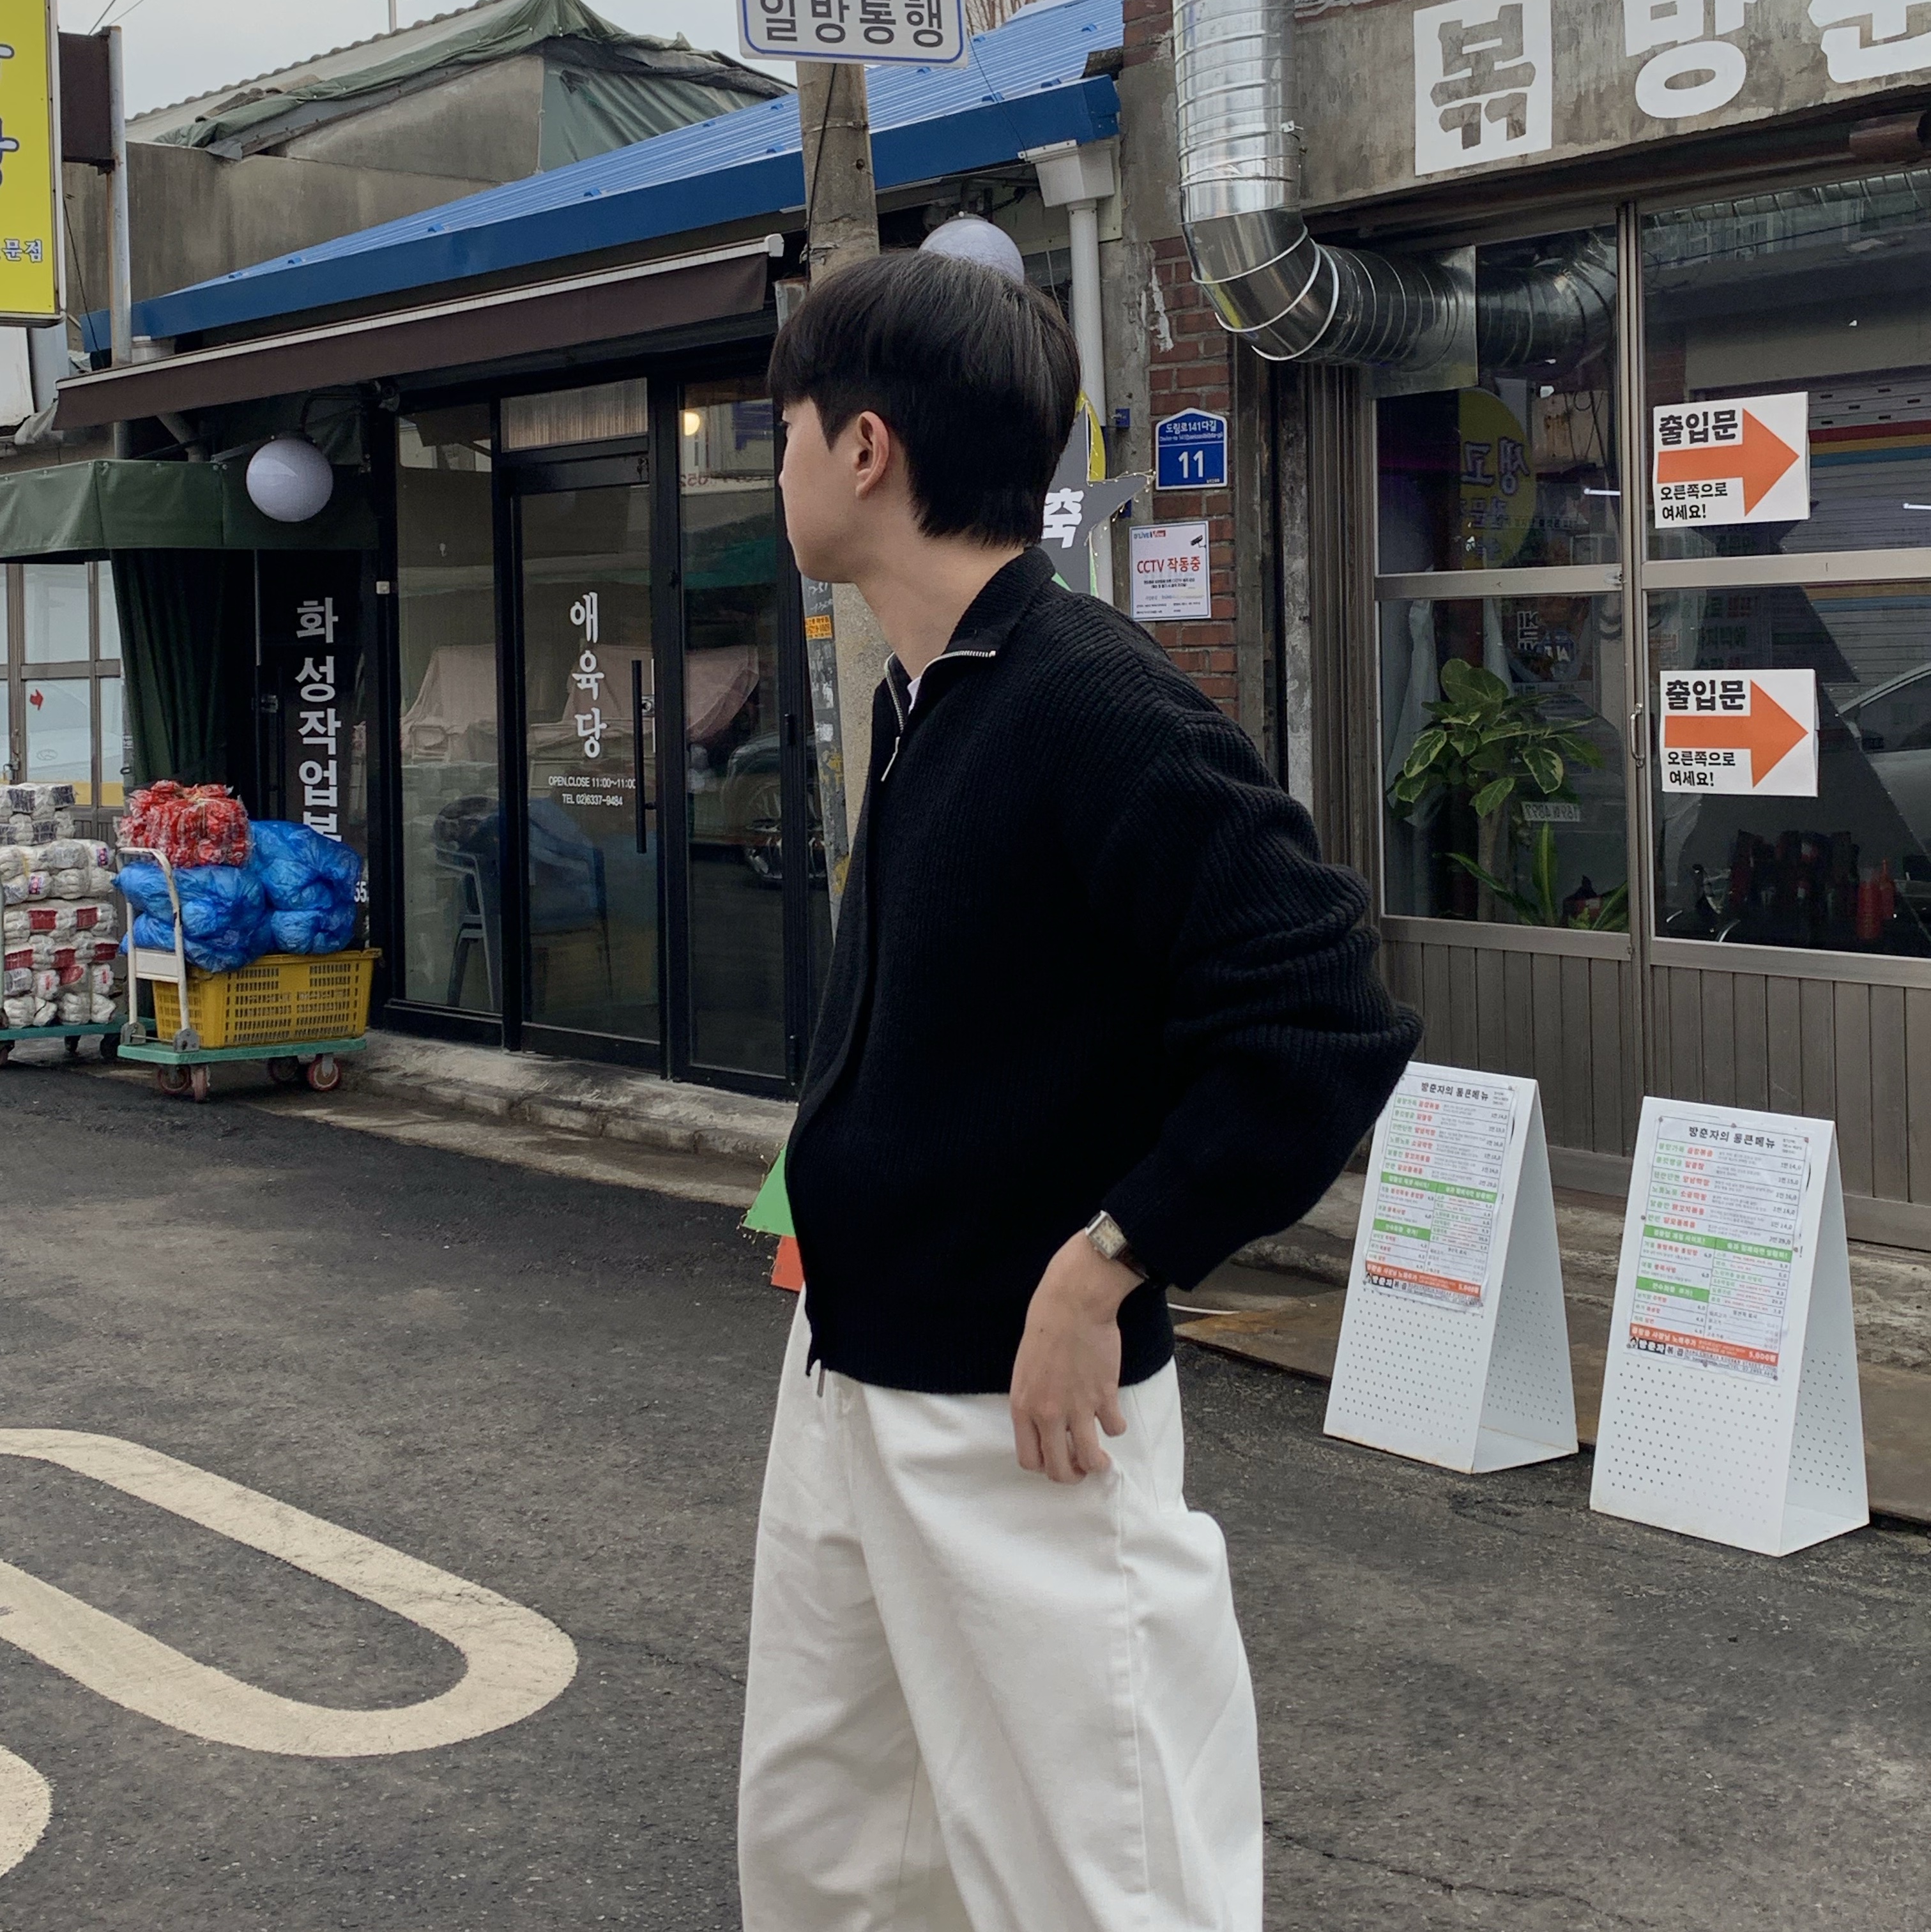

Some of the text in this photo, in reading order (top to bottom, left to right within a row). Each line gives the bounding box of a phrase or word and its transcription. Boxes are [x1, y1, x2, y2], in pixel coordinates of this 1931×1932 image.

[761, 0, 944, 47] 일방통행
[1659, 409, 1738, 446] 출입문
[1178, 450, 1203, 479] 11
[1660, 482, 1728, 501] 오른쪽으로
[1662, 503, 1706, 521] 여세요!
[1137, 555, 1201, 574] CCTV 작동중
[570, 591, 607, 758] 애육당
[1665, 680, 1746, 711] 출입문
[1668, 750, 1736, 767] 오른쪽으로
[1670, 771, 1714, 787] 여세요!
[562, 793, 575, 805] TEL
